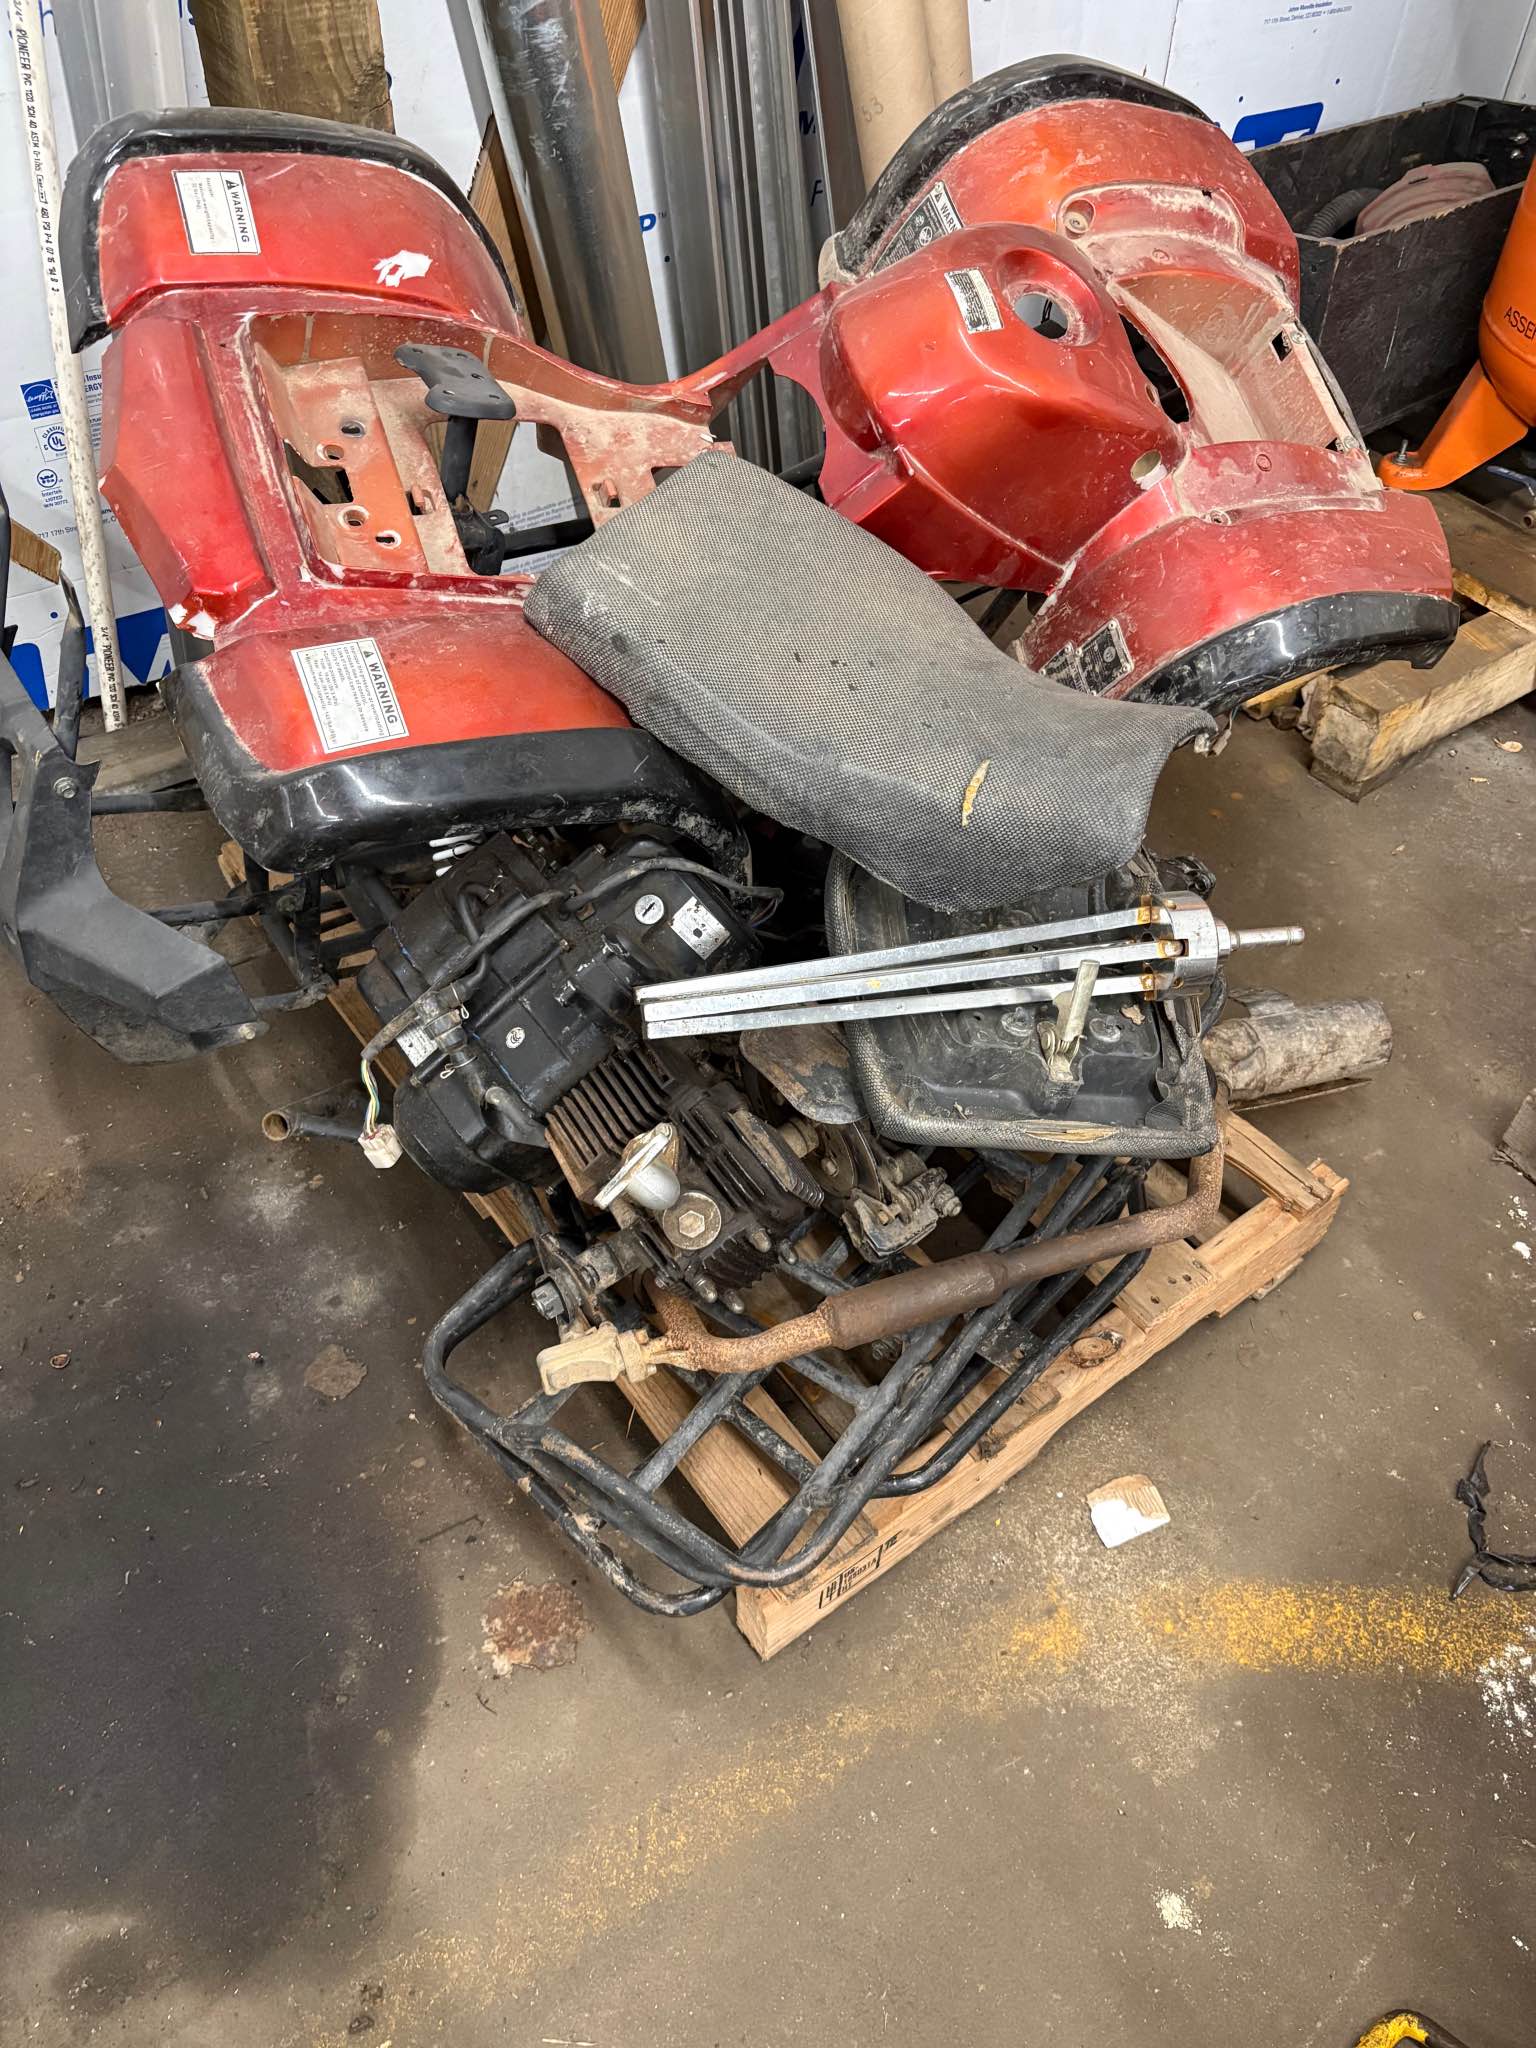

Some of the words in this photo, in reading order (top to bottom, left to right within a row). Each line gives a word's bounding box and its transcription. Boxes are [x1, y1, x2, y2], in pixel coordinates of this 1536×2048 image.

[16, 28, 31, 70] PIONEER
[21, 73, 32, 86] PVC
[230, 191, 250, 243] WARNING
[103, 643, 115, 672] PIONEER
[369, 662, 397, 724] WARNING
